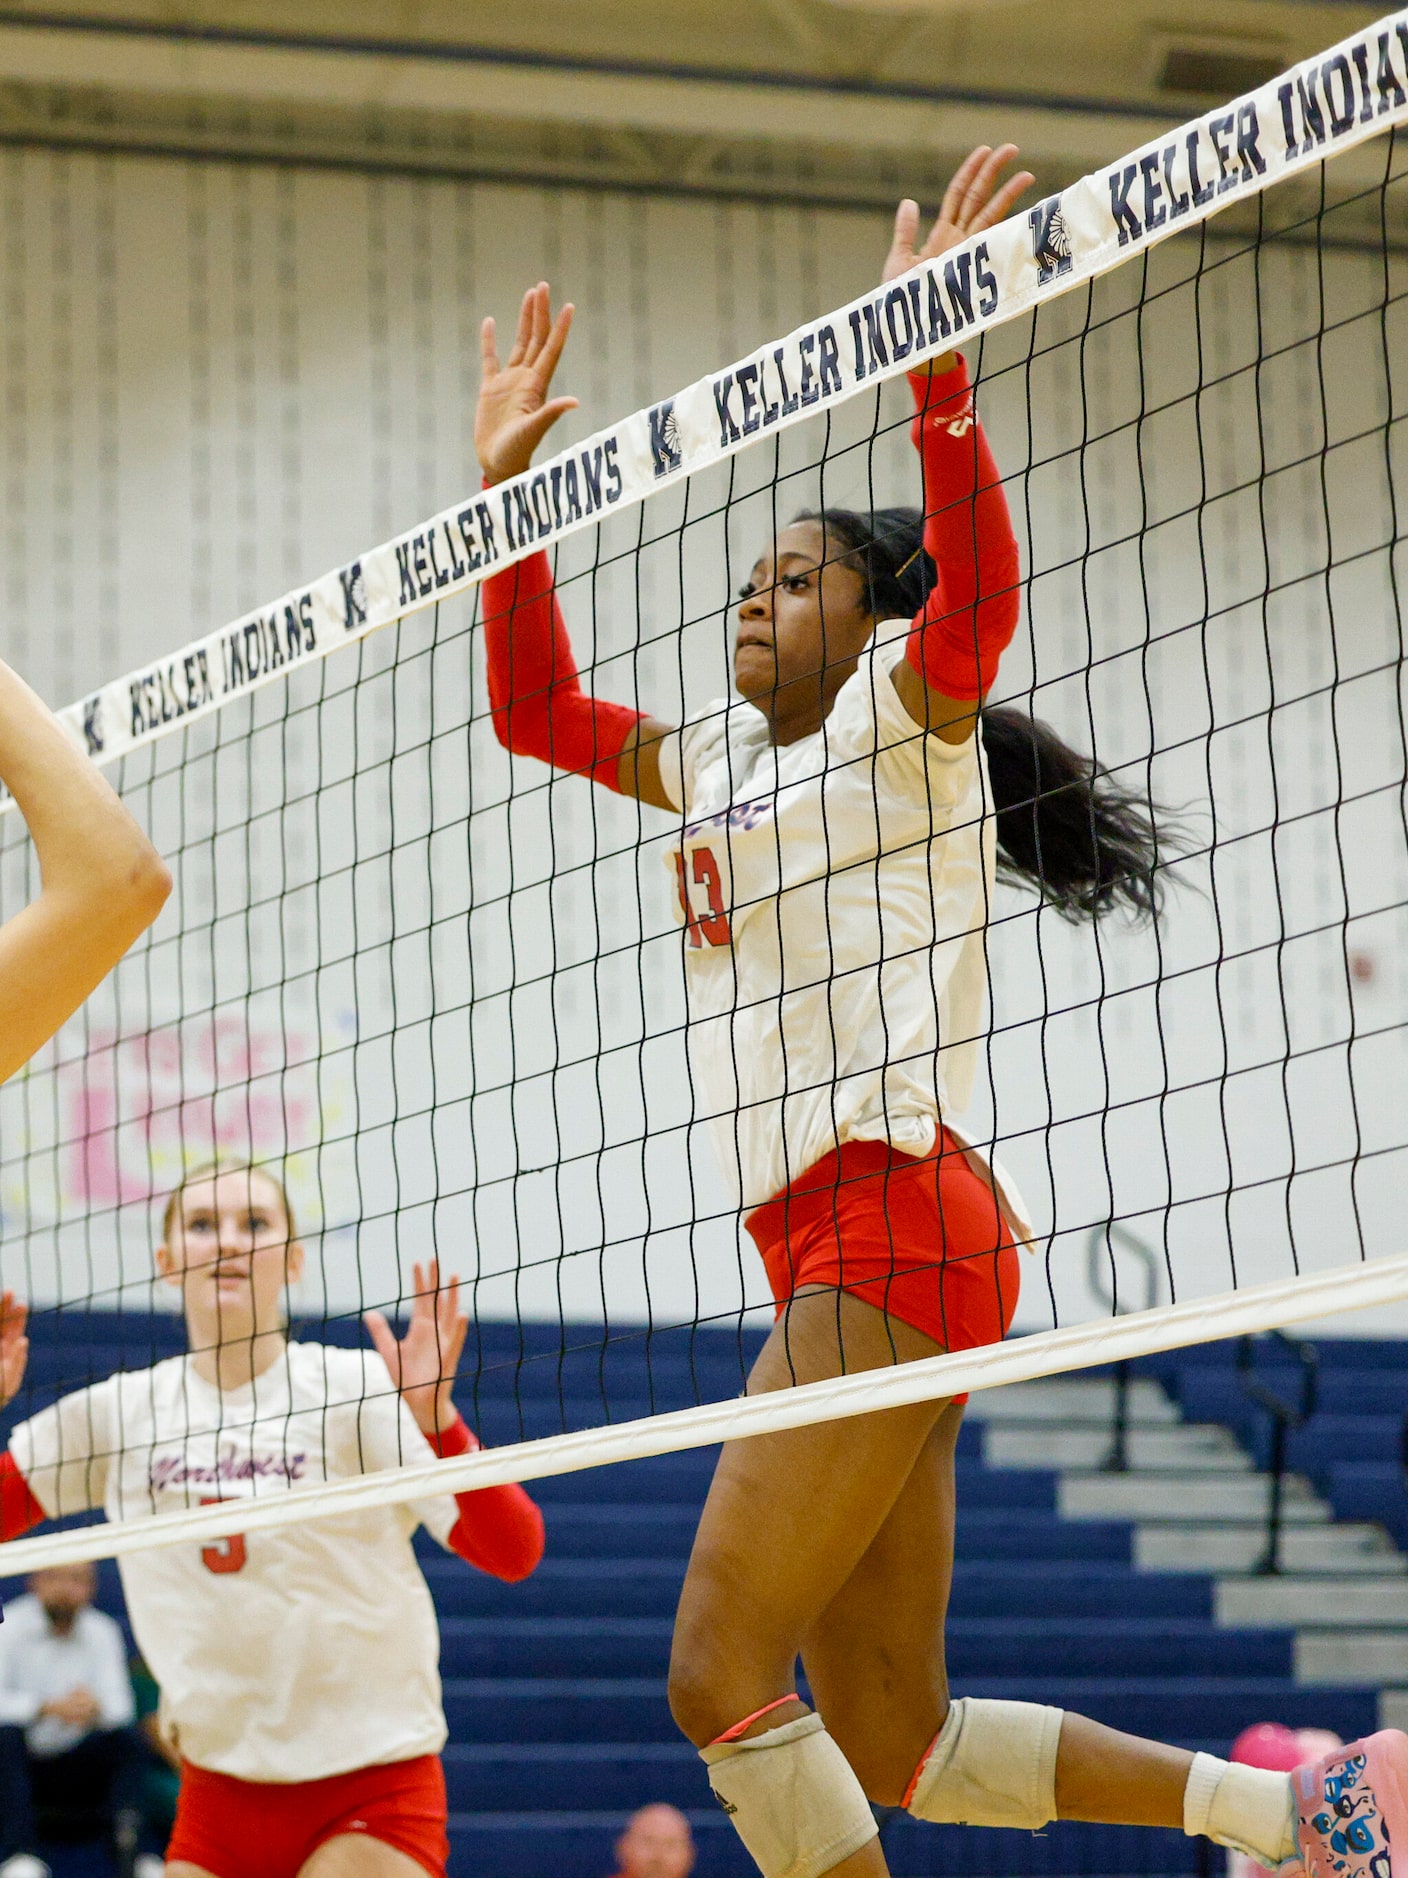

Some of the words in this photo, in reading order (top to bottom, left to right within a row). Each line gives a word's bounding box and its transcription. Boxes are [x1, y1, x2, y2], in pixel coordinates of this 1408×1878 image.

[1108, 102, 1266, 246] KELLER
[712, 324, 843, 447] KELLER
[848, 241, 999, 380] INDIANS
[395, 502, 500, 606] KELLER
[501, 436, 623, 551] INDIANS
[128, 648, 216, 738] KELLER
[219, 591, 317, 696] INDIANS
